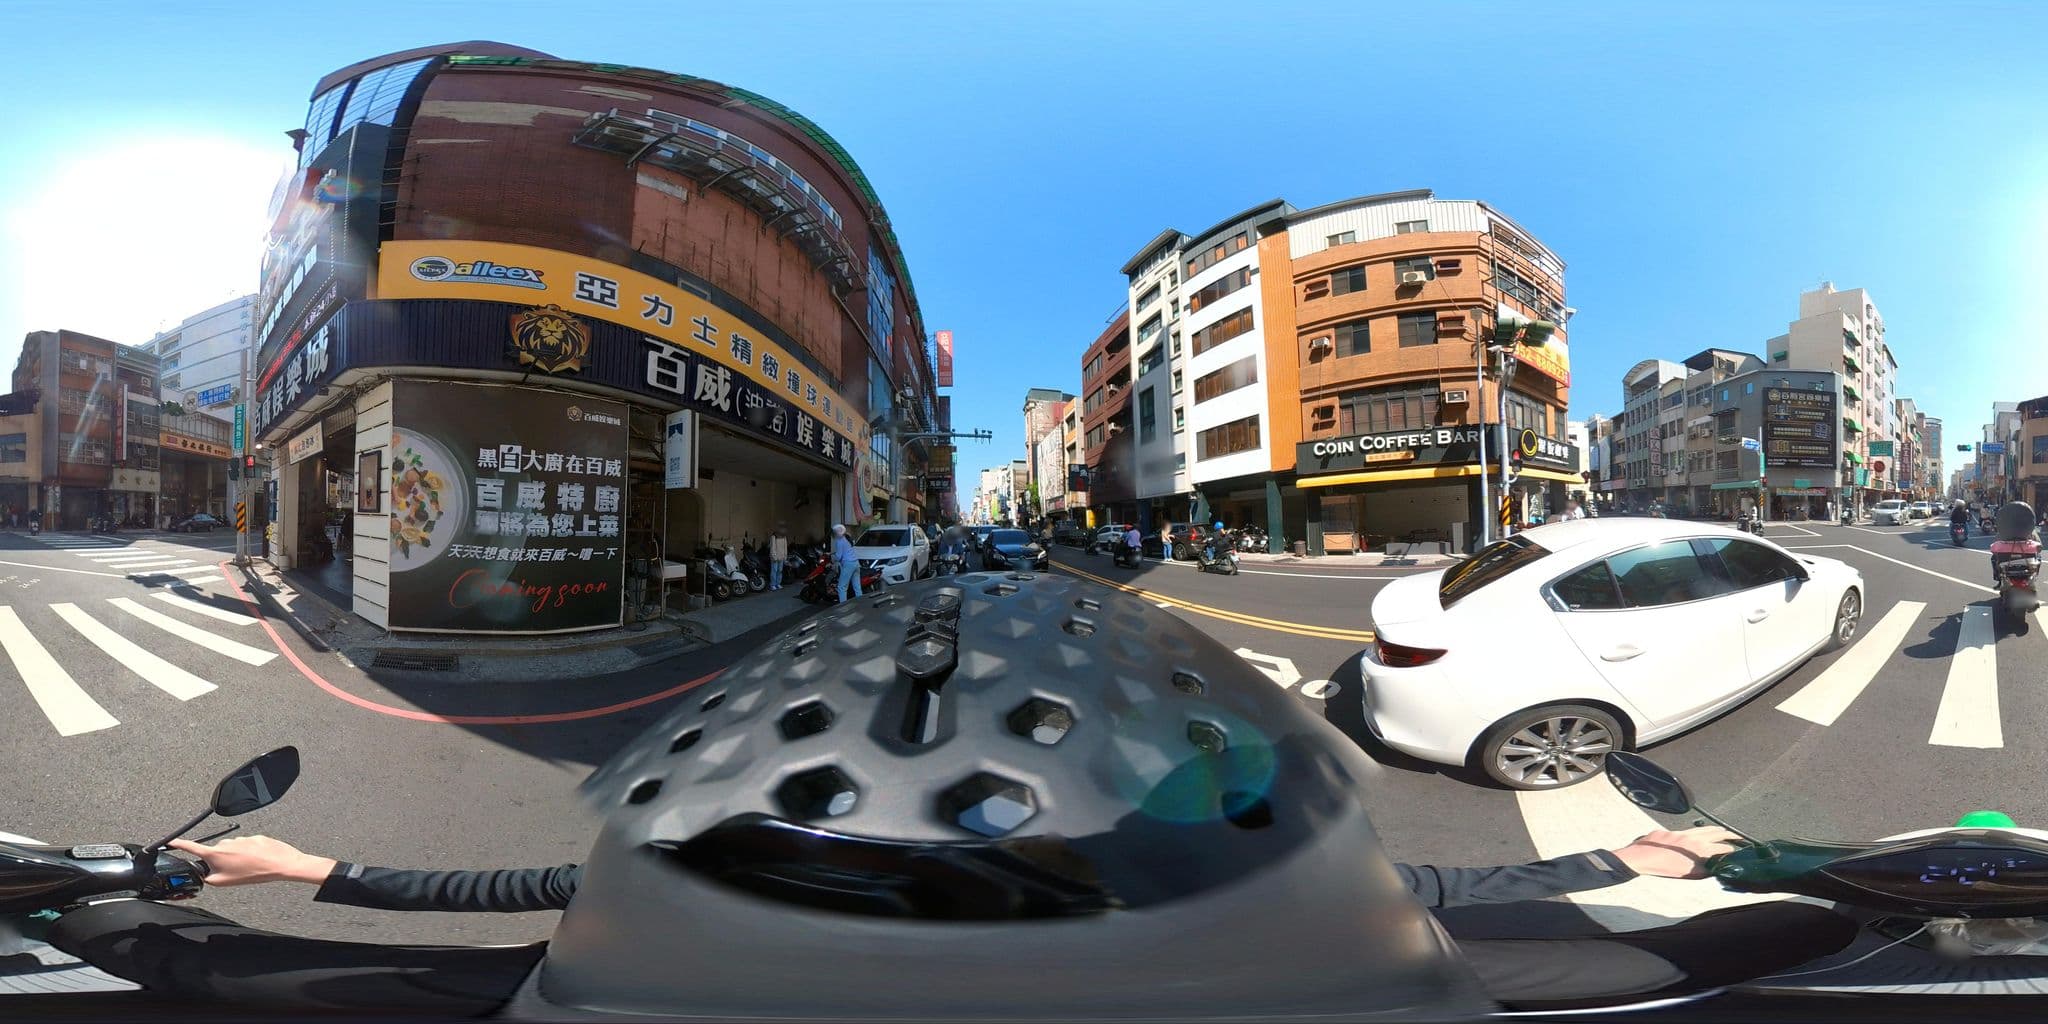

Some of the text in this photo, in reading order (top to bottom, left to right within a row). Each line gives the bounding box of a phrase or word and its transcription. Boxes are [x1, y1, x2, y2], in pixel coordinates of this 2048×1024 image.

[584, 413, 621, 425] 百威娛樂城
[1313, 430, 1479, 456] COIN COFFEE BAR
[475, 478, 620, 512] 百威特廚
